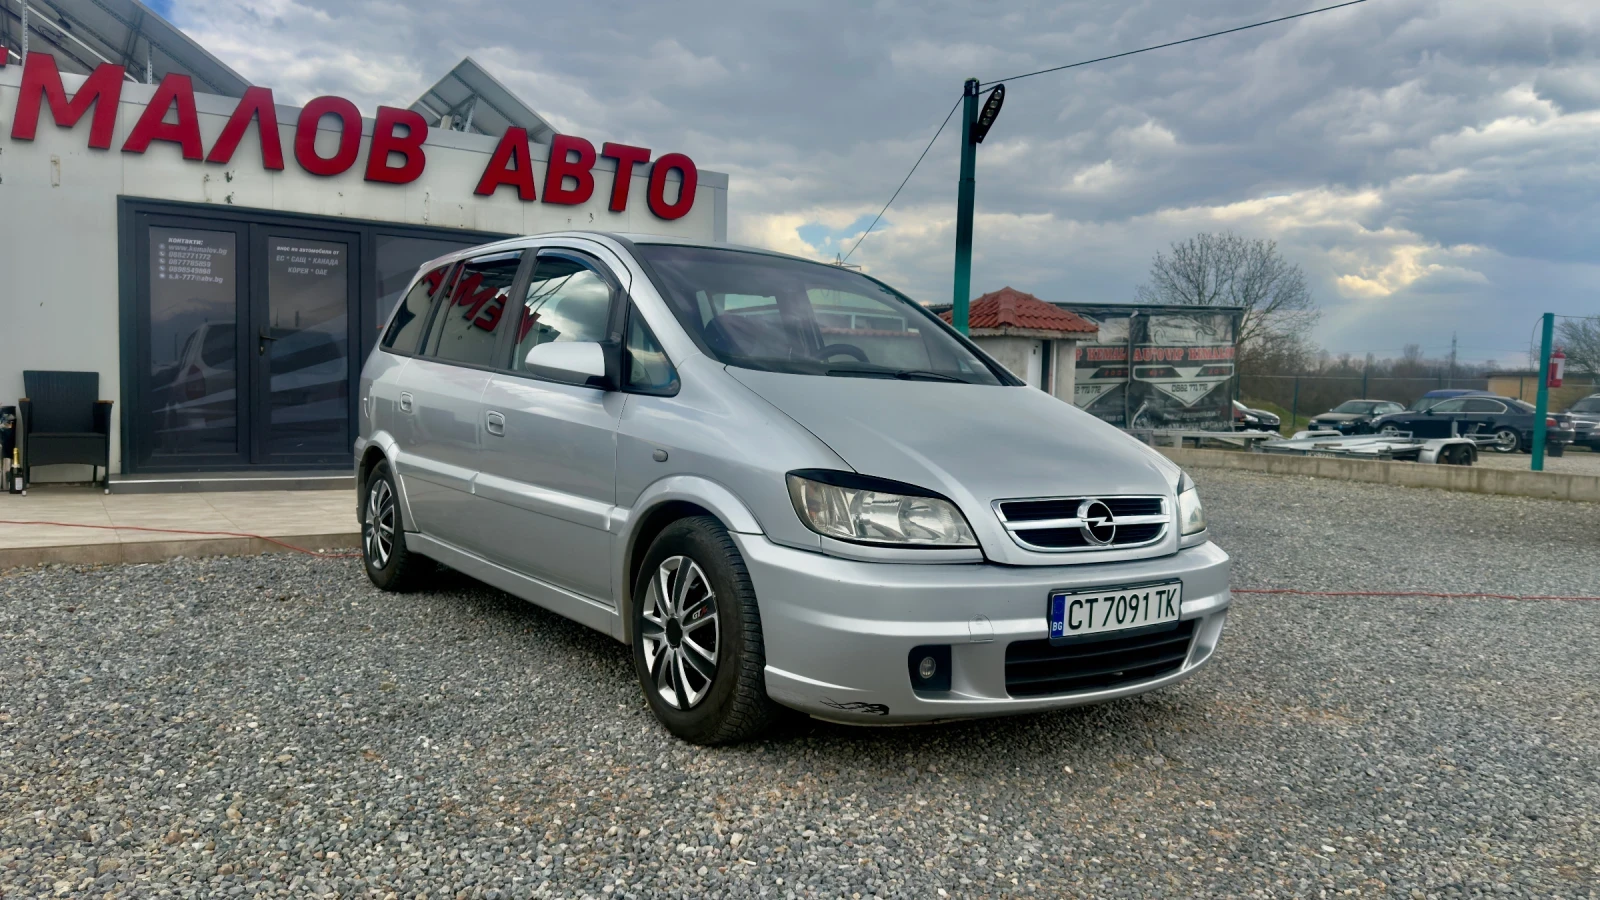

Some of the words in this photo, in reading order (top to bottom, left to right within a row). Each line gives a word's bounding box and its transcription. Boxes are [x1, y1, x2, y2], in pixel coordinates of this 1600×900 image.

[0, 47, 428, 184] МАЛОВ
[474, 127, 698, 221] АВТО
[313, 258, 339, 266] КАНАДА
[1133, 347, 1184, 362] AUTOVIP
[1068, 598, 1099, 630] CT
[1102, 592, 1150, 626] 7091
[1155, 588, 1177, 618] TK
[1052, 621, 1063, 631] BG
